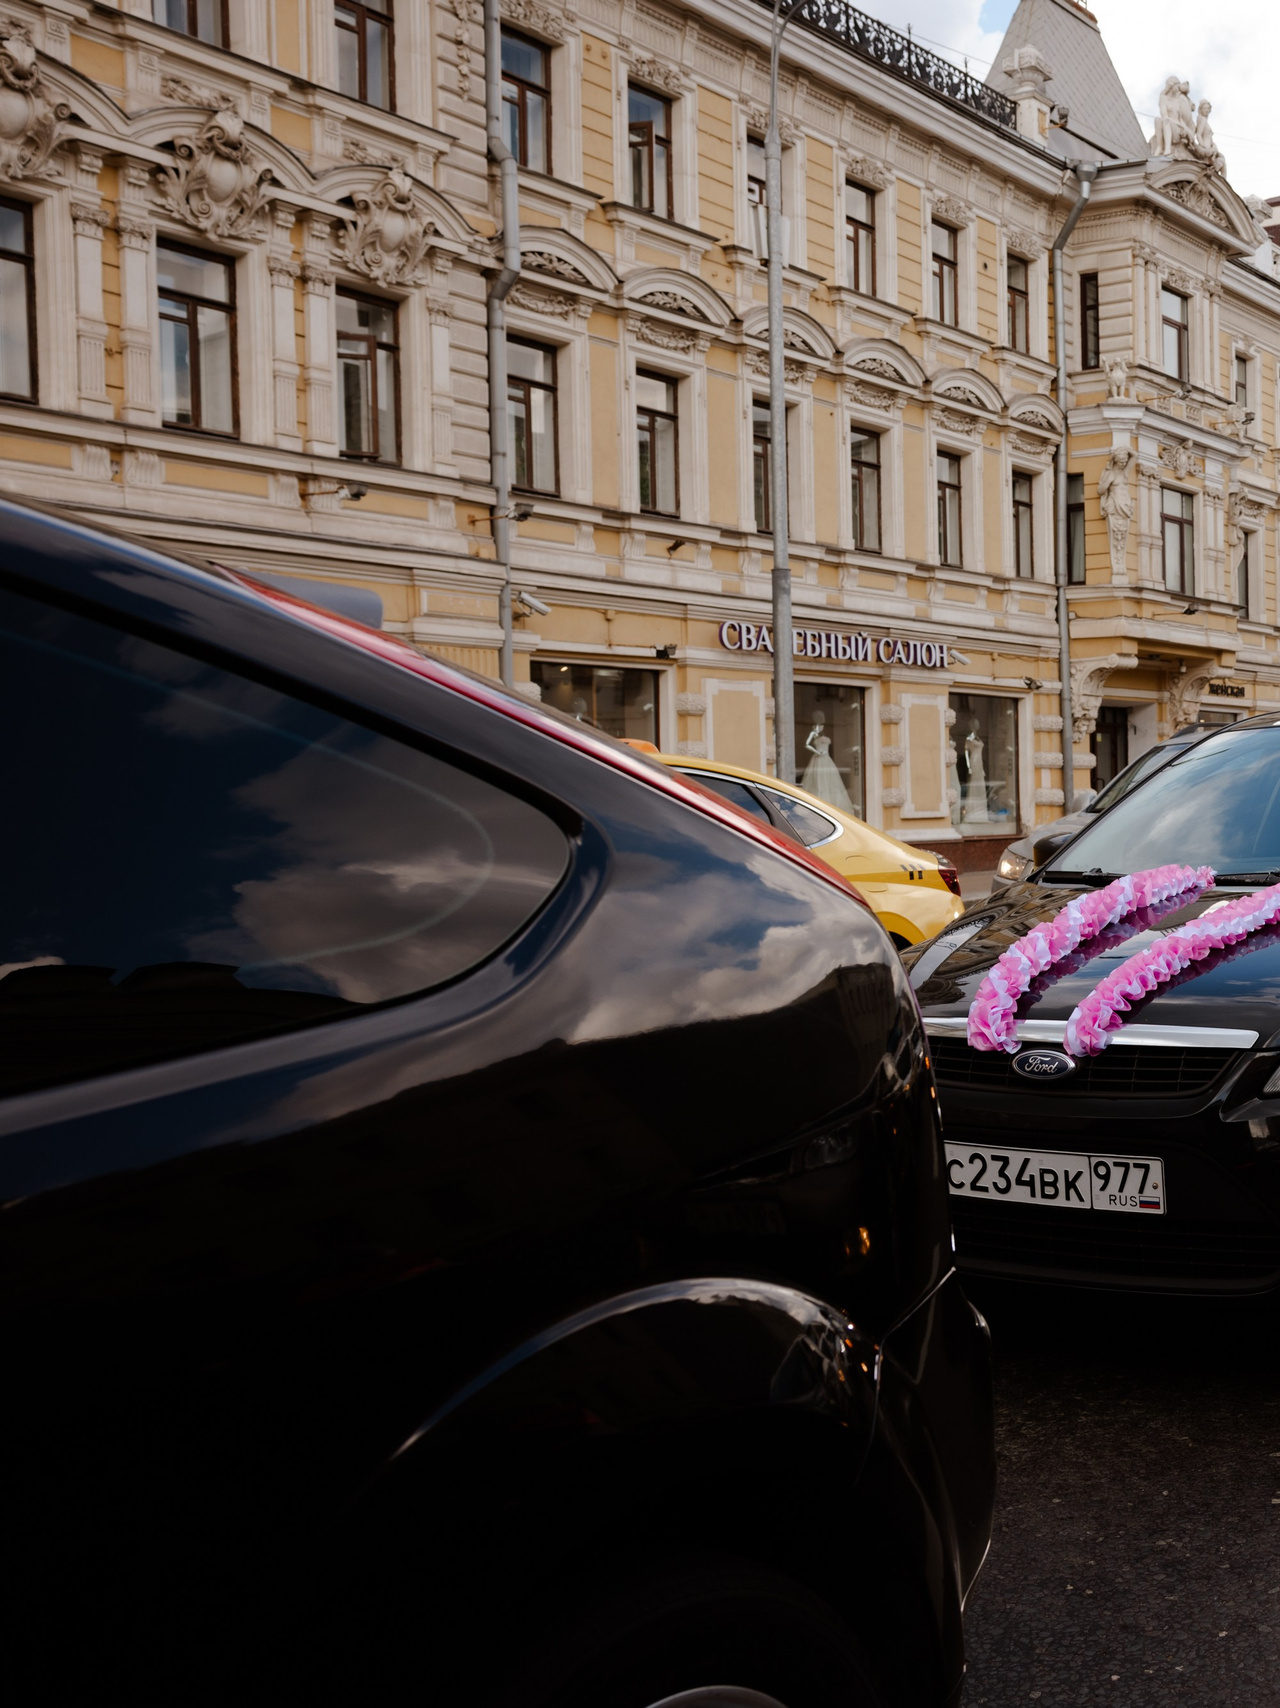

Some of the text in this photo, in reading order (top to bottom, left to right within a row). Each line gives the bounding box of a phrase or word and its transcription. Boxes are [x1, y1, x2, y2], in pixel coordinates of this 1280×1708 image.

[719, 621, 948, 668] СВАЕБНЫЙ САЛОН
[1024, 1055, 1060, 1074] Ford
[1093, 1160, 1151, 1195] 977
[1108, 1194, 1138, 1208] RUS
